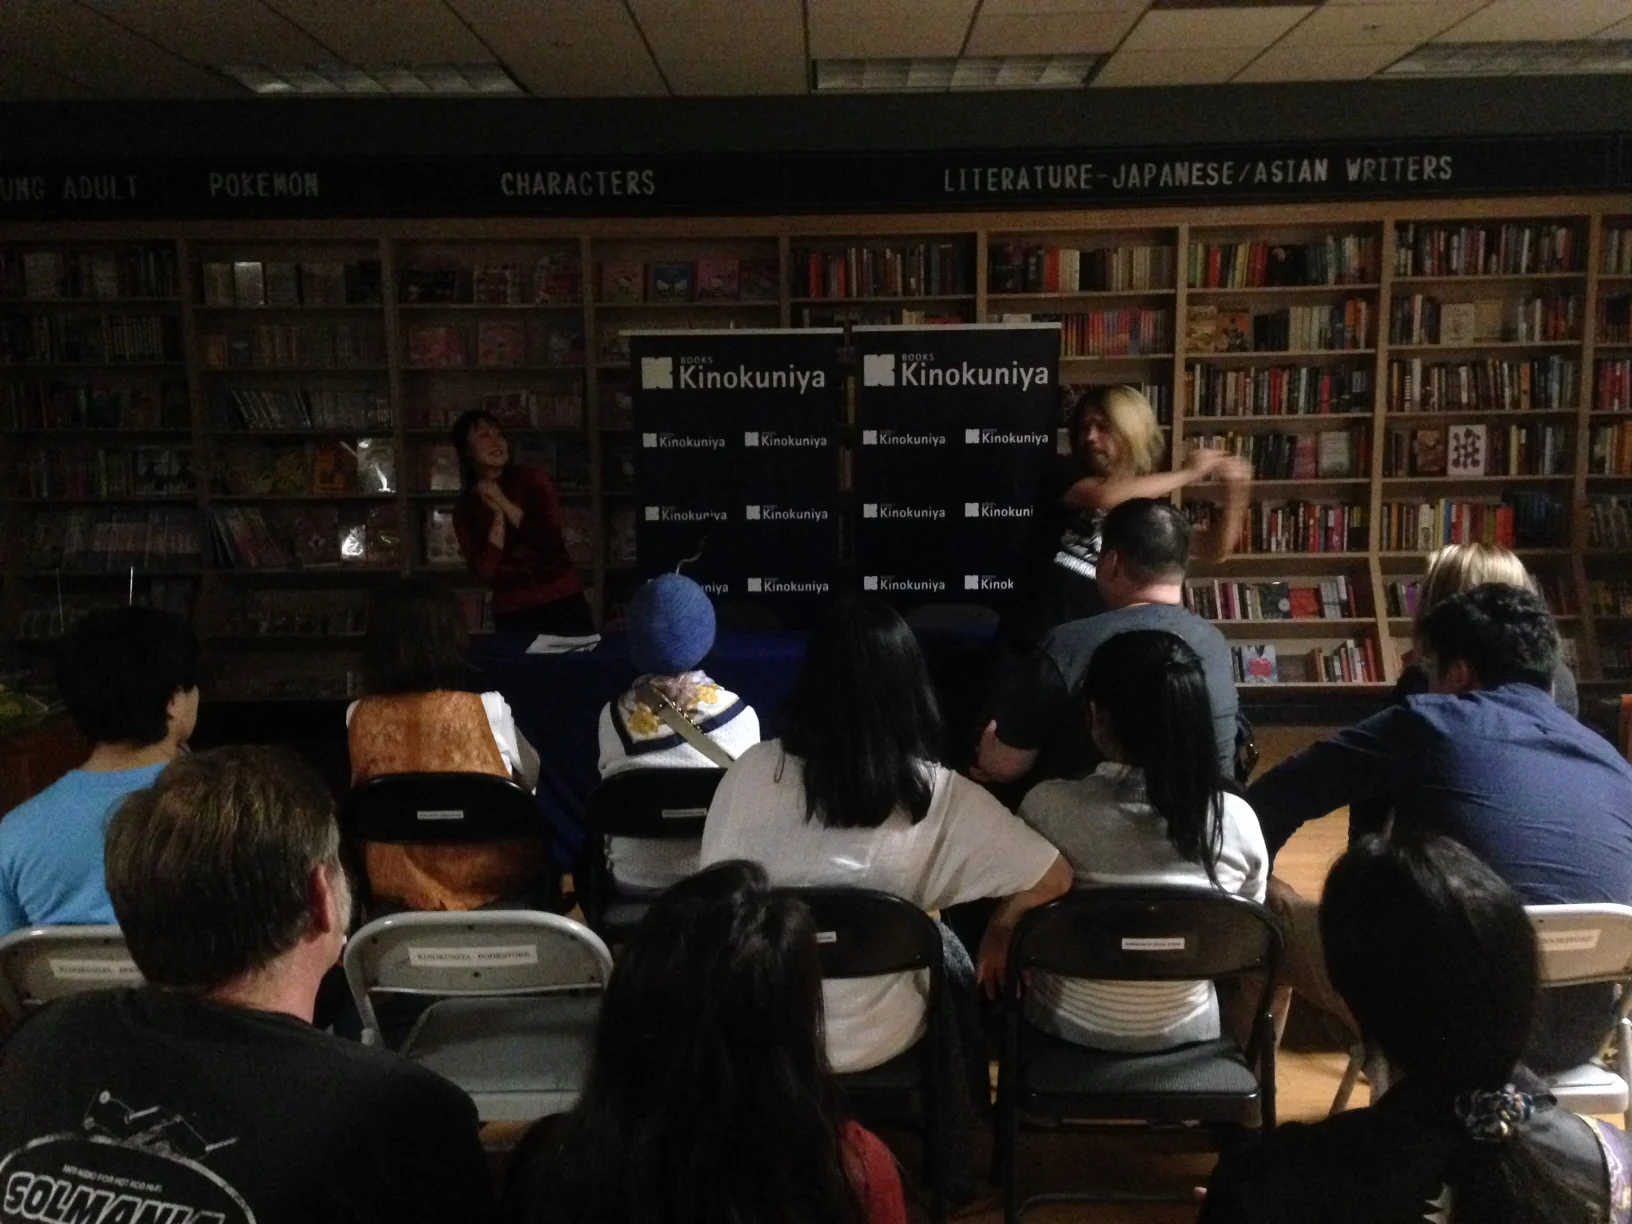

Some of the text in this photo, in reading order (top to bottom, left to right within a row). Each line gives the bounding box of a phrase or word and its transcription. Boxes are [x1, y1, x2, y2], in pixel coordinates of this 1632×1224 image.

[1346, 154, 1454, 183] WRITERS
[0, 174, 138, 202] UNG ADULT
[500, 169, 656, 196] CHARACTERS
[680, 356, 713, 364] BOOKS
[900, 353, 935, 362] BOOKS
[679, 364, 826, 395] Kinokuniya
[901, 361, 1049, 392] Kinokuniya
[659, 435, 726, 450] Kinokuniya
[761, 433, 827, 448] Kinokuniya
[879, 433, 946, 448] Kinokuniya
[982, 432, 1049, 446] Kinokuniya
[762, 508, 828, 523] Kinokuniya
[880, 506, 946, 521] Kinokuniya
[981, 505, 1034, 518] Kinokuni
[763, 581, 830, 595] Kinokuniya
[880, 579, 946, 593] Kinokuniya
[981, 578, 1015, 590] Kinok
